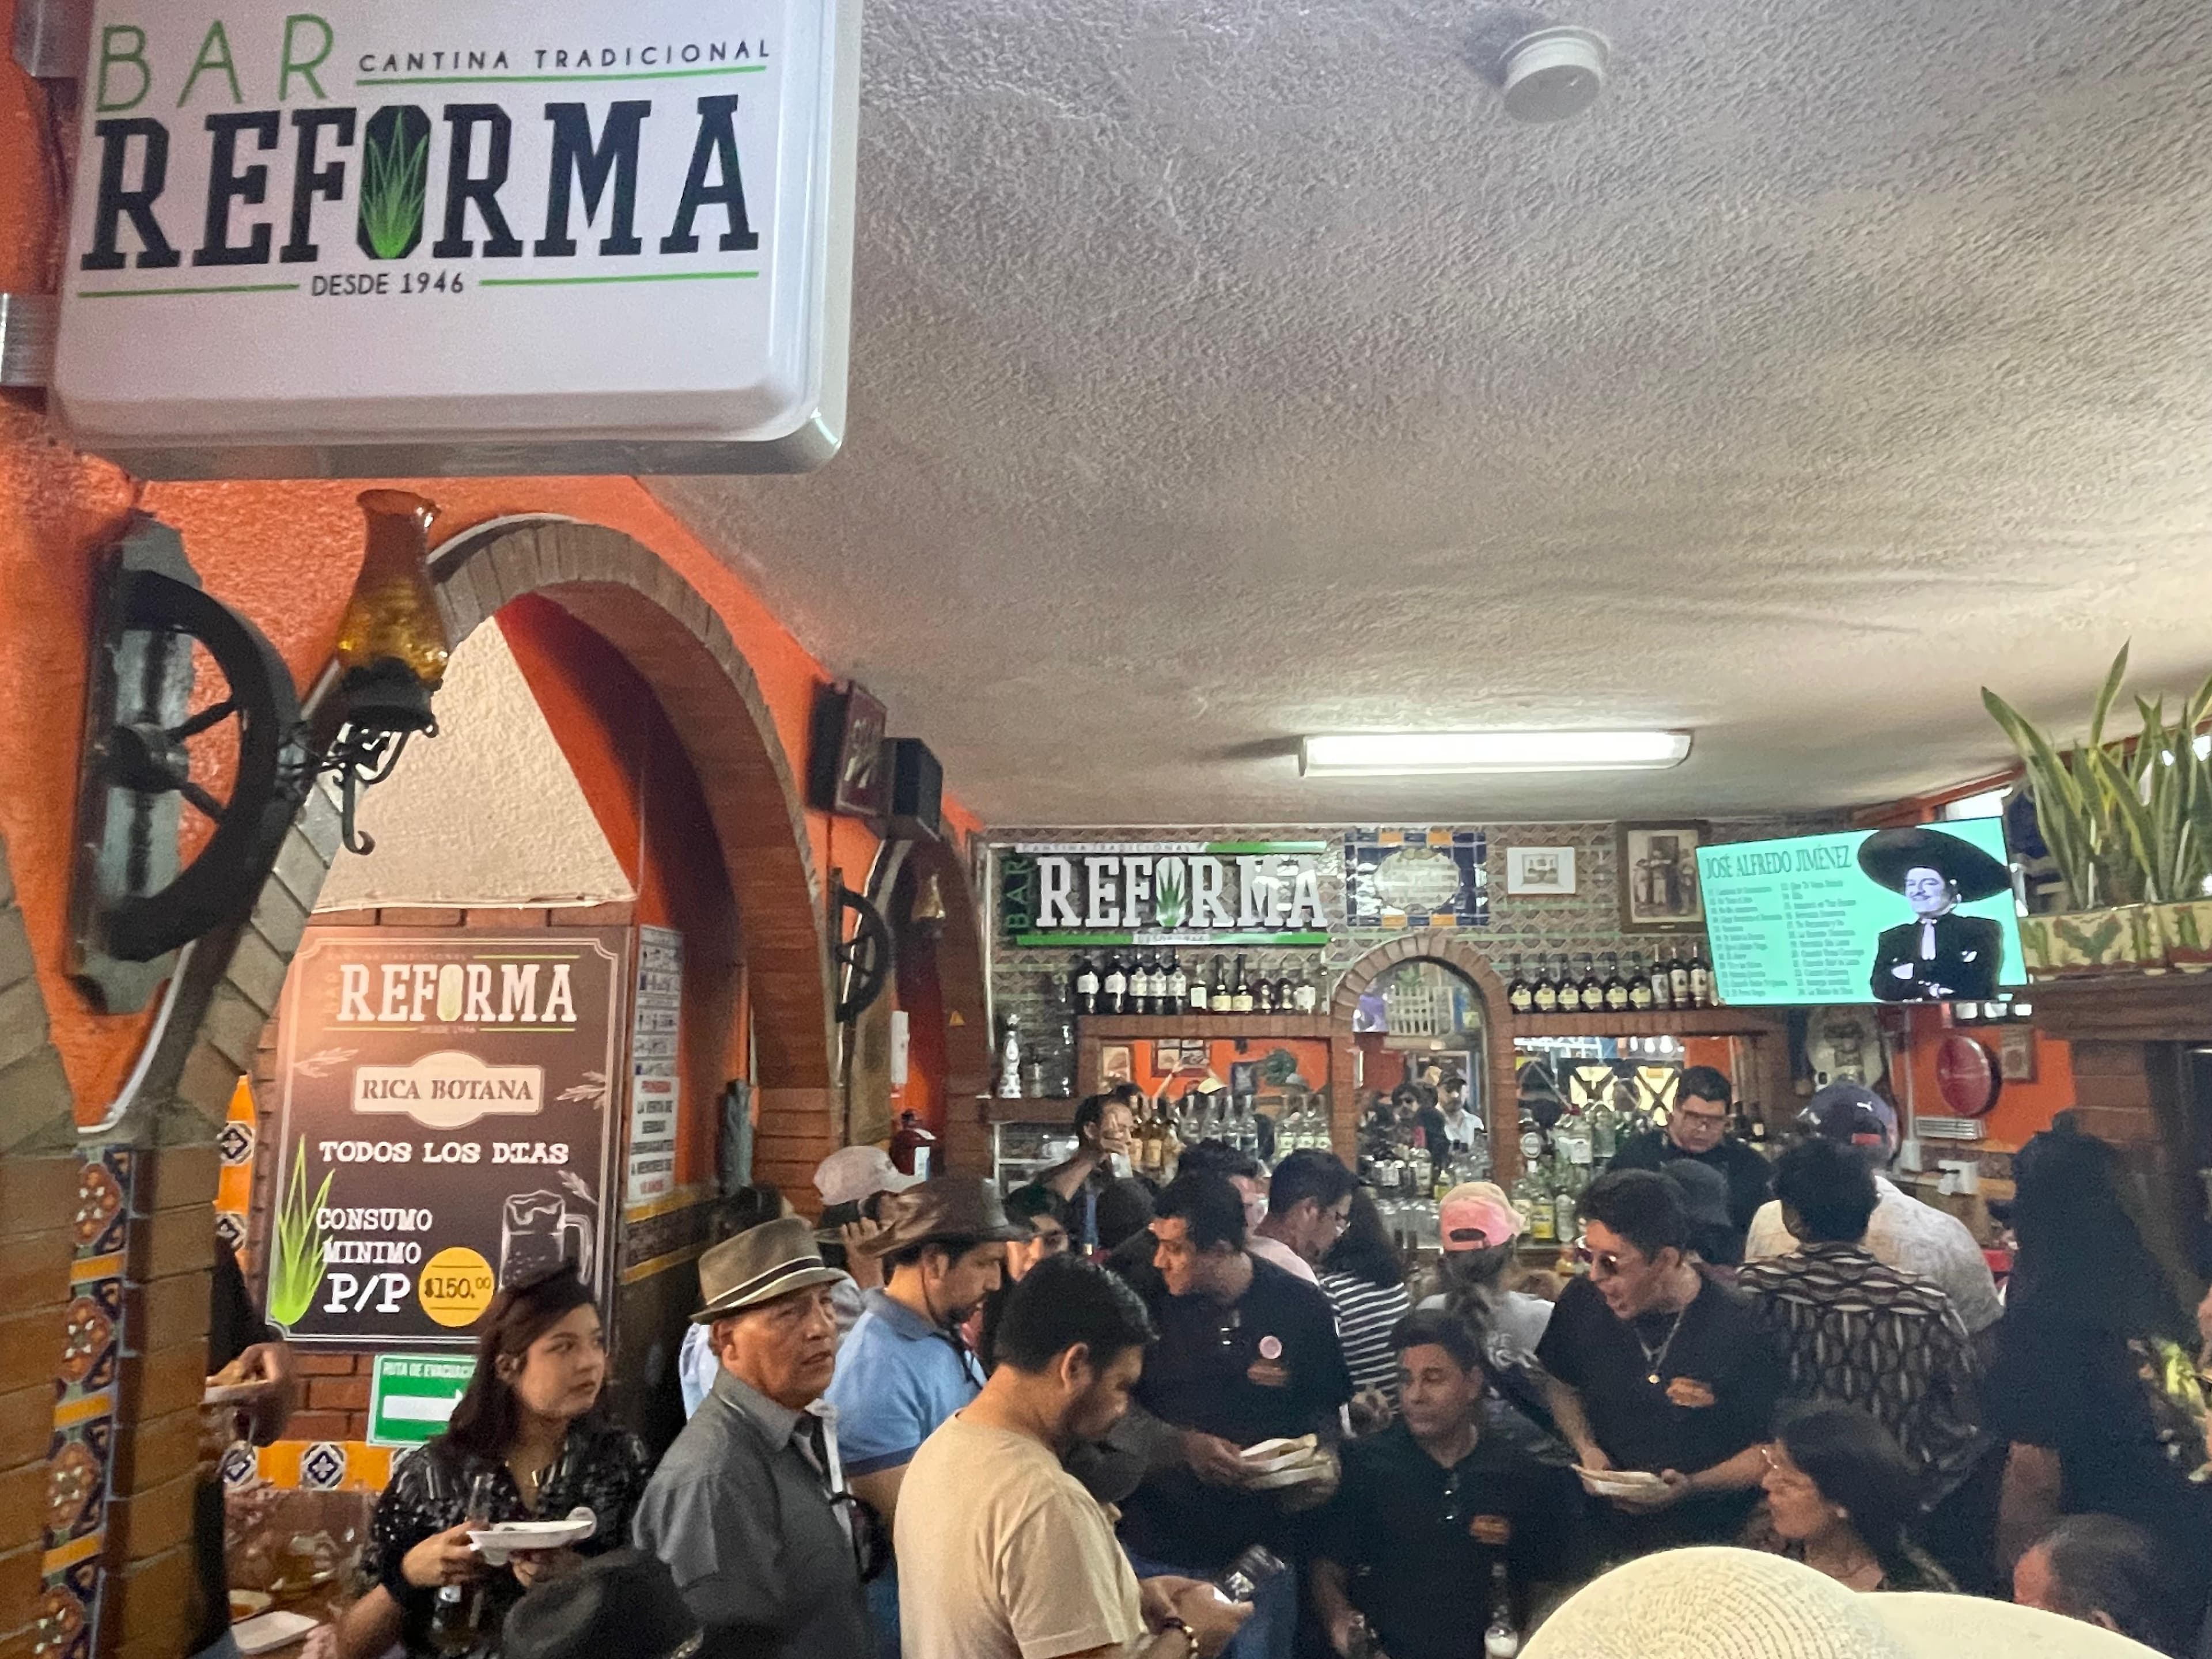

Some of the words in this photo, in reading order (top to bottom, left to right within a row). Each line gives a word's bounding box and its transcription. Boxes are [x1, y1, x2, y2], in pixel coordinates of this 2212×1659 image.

[96, 13, 335, 112] BAR
[359, 51, 509, 73] CANTINA
[535, 40, 770, 70] TRADICIONAL
[80, 94, 759, 271] REFORMA
[310, 272, 390, 297] DESDE
[400, 268, 465, 295] 1946
[1006, 859, 1029, 930] BAR
[1037, 856, 1328, 927] REFORMA
[336, 963, 577, 1022] REFORMA
[361, 1079, 421, 1100] RICA
[431, 1079, 534, 1101] BOTANA
[319, 1141, 412, 1164] TODOS
[422, 1142, 481, 1164] LOS
[491, 1142, 570, 1165] DIAS
[315, 1207, 433, 1232] CONSUMO
[321, 1241, 422, 1265] MINIMO
[323, 1272, 411, 1313] P/P
